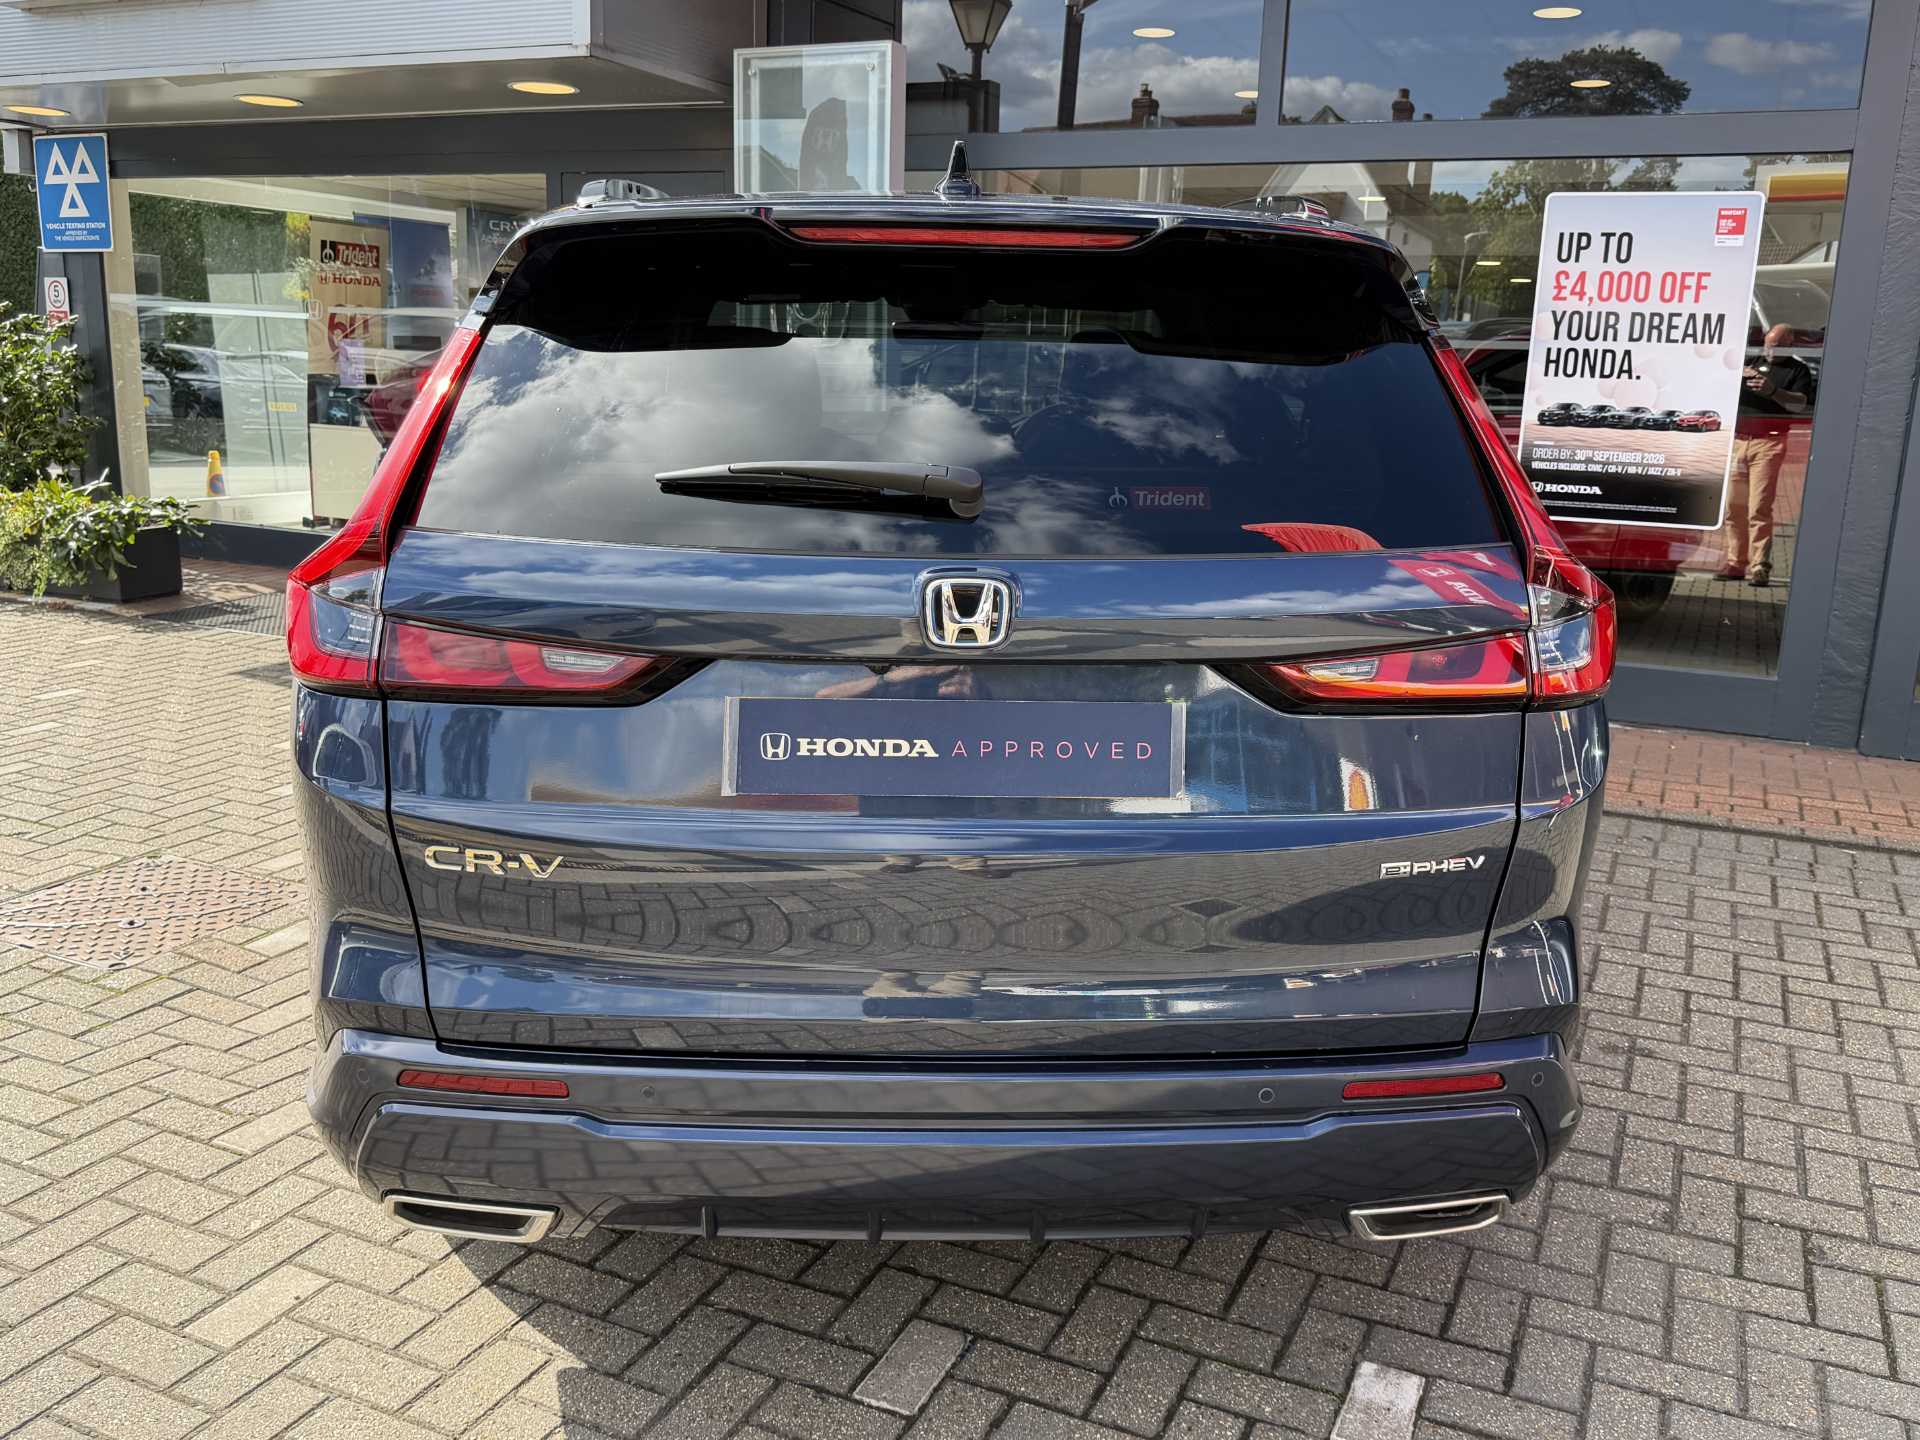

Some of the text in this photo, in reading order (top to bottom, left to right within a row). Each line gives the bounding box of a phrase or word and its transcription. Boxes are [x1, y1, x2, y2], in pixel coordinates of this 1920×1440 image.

[337, 245, 378, 266] Trident
[1556, 232, 1634, 264] UP TO
[332, 273, 382, 287] HONDA
[1552, 270, 1712, 306] £4,000 OFF
[53, 284, 60, 298] 5
[1550, 310, 1726, 345] YOUR DREAM
[1543, 347, 1642, 381] HONDA.
[1531, 461, 1558, 470] VEHICLES
[1532, 448, 1560, 460] ORDER
[1560, 449, 1574, 460] BY:
[1593, 451, 1642, 464] SEPTEMBER
[1135, 490, 1206, 507] Trident
[1544, 483, 1603, 495] HONDA
[796, 738, 1153, 760] HONDA APPROVED
[424, 845, 565, 879] CR-V
